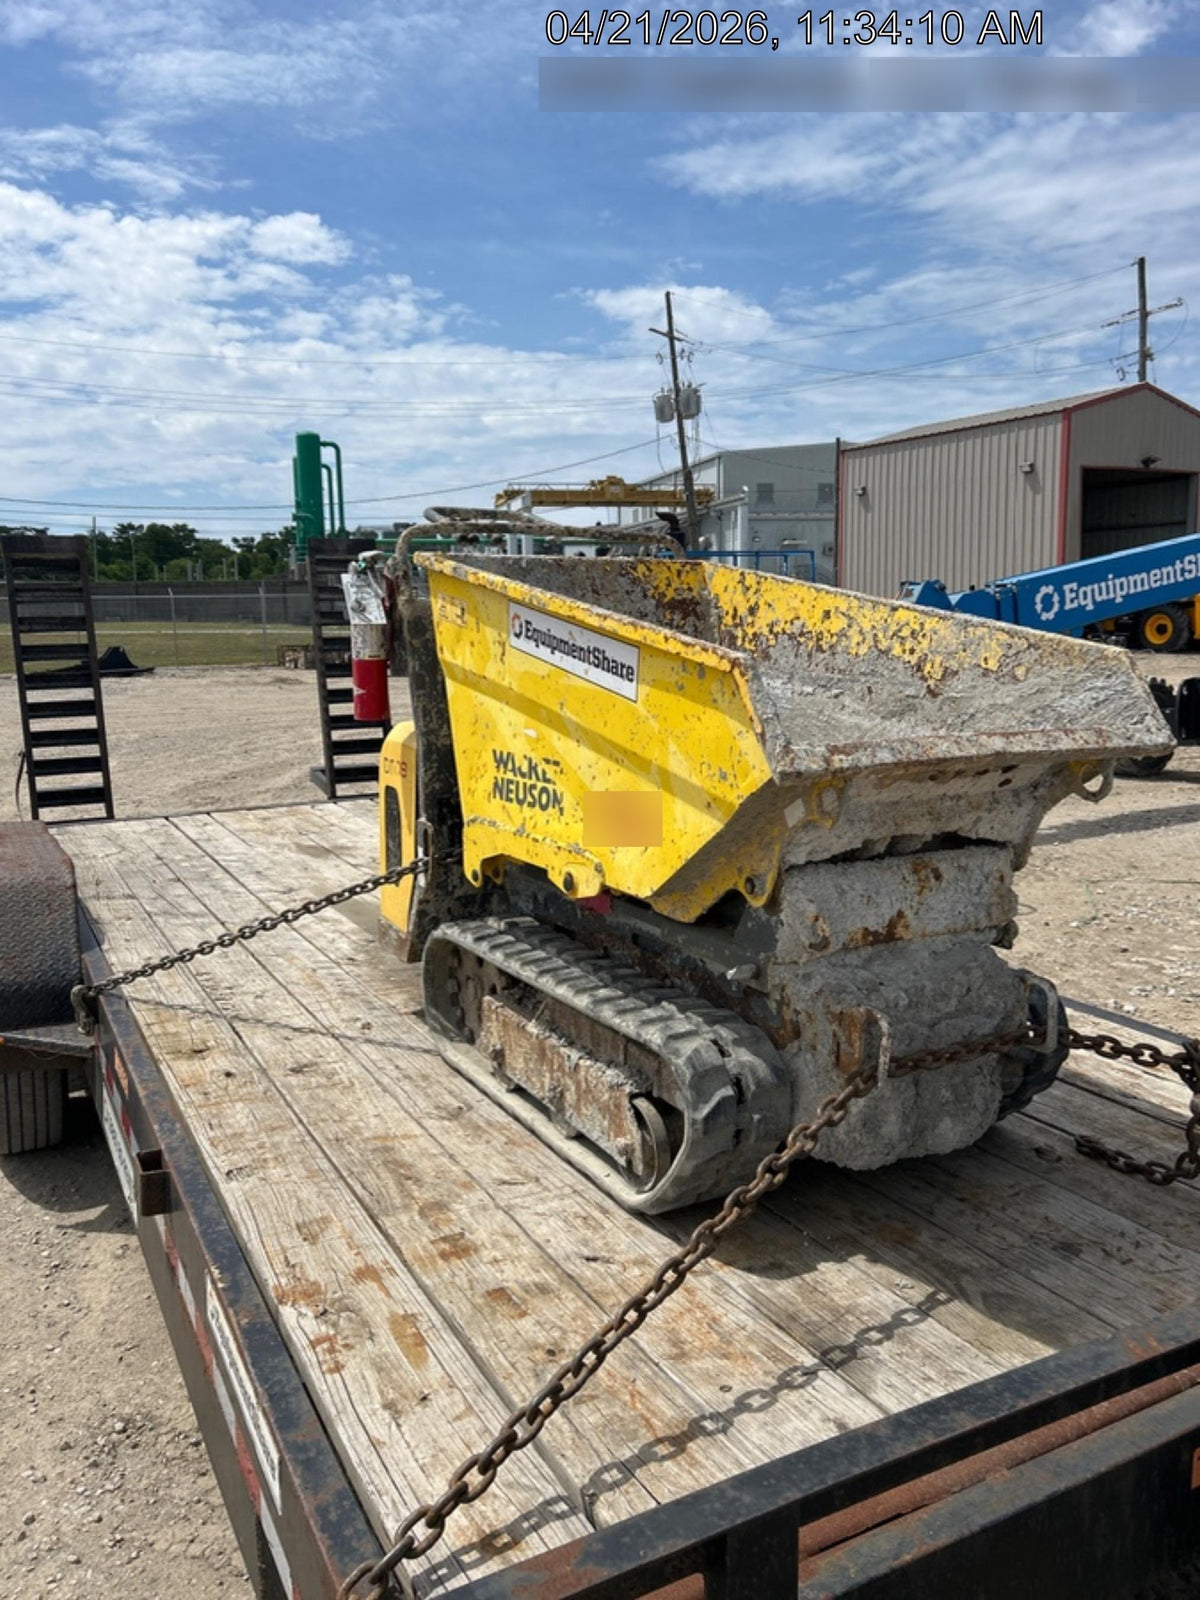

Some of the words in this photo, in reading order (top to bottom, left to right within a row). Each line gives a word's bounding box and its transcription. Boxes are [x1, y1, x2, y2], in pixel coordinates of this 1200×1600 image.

[1063, 552, 1200, 611] EquipmentS
[524, 619, 635, 683] EquipmentShare
[492, 775, 564, 816] NEUSON
